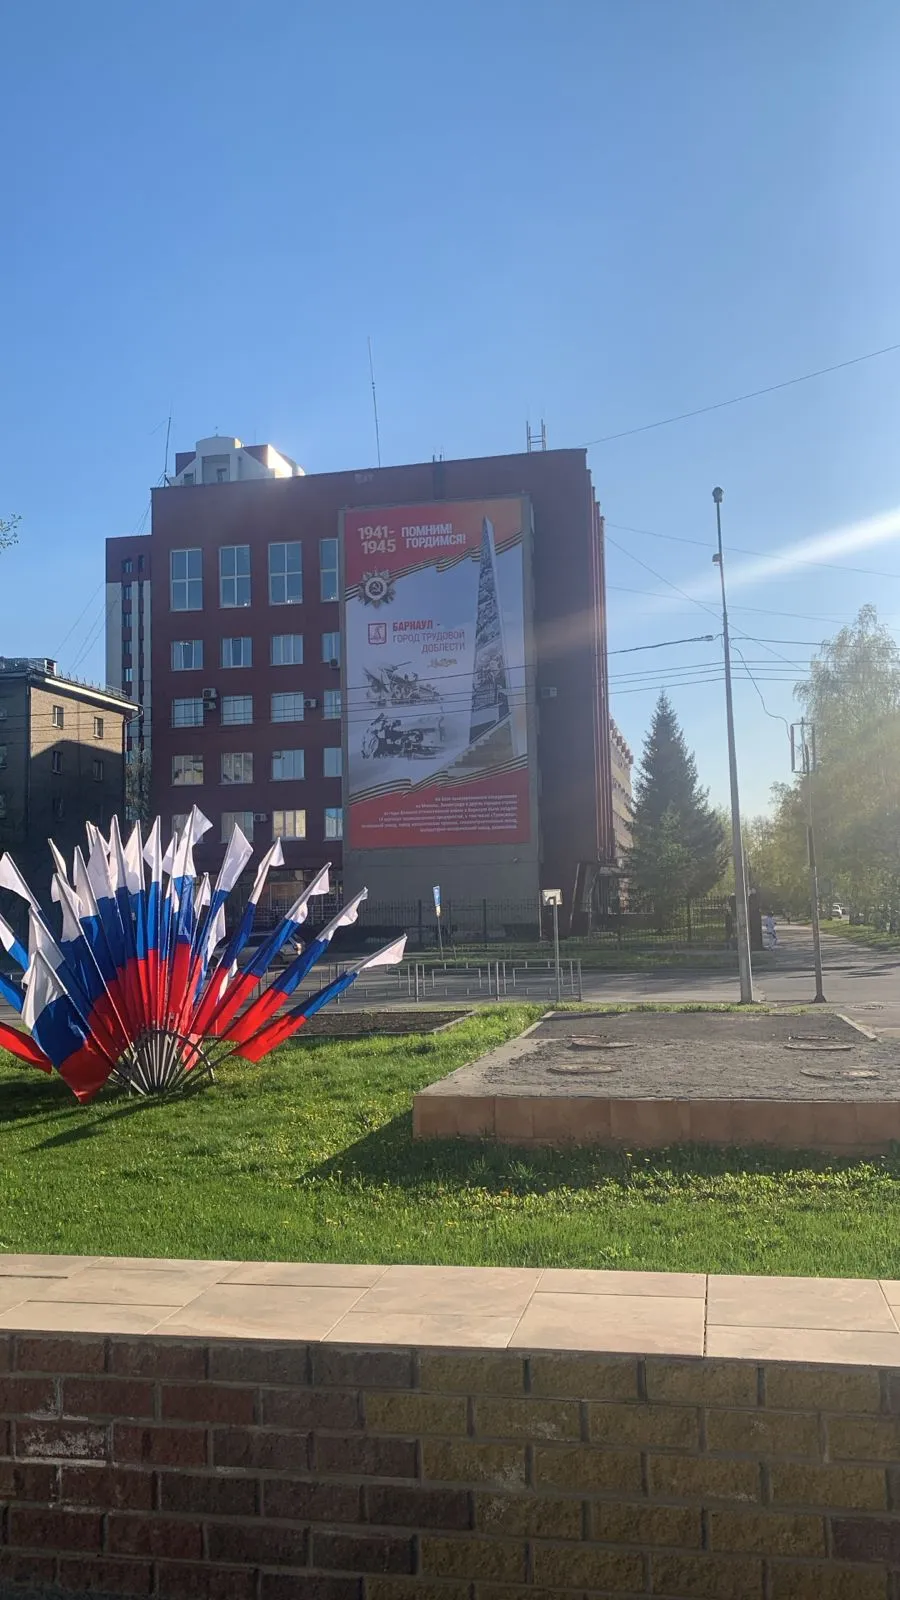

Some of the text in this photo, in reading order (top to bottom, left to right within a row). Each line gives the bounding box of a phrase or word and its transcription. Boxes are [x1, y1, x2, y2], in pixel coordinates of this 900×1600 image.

[358, 525, 395, 540] 1941-
[401, 523, 452, 537] ПОМНИМ!
[361, 540, 396, 554] 1945
[406, 533, 466, 549] ГОРДИМСЯ!
[392, 620, 433, 632] БАРНАУЛ
[393, 633, 420, 643] ГОРОД
[421, 642, 465, 654] ДОБЛЕСТИ
